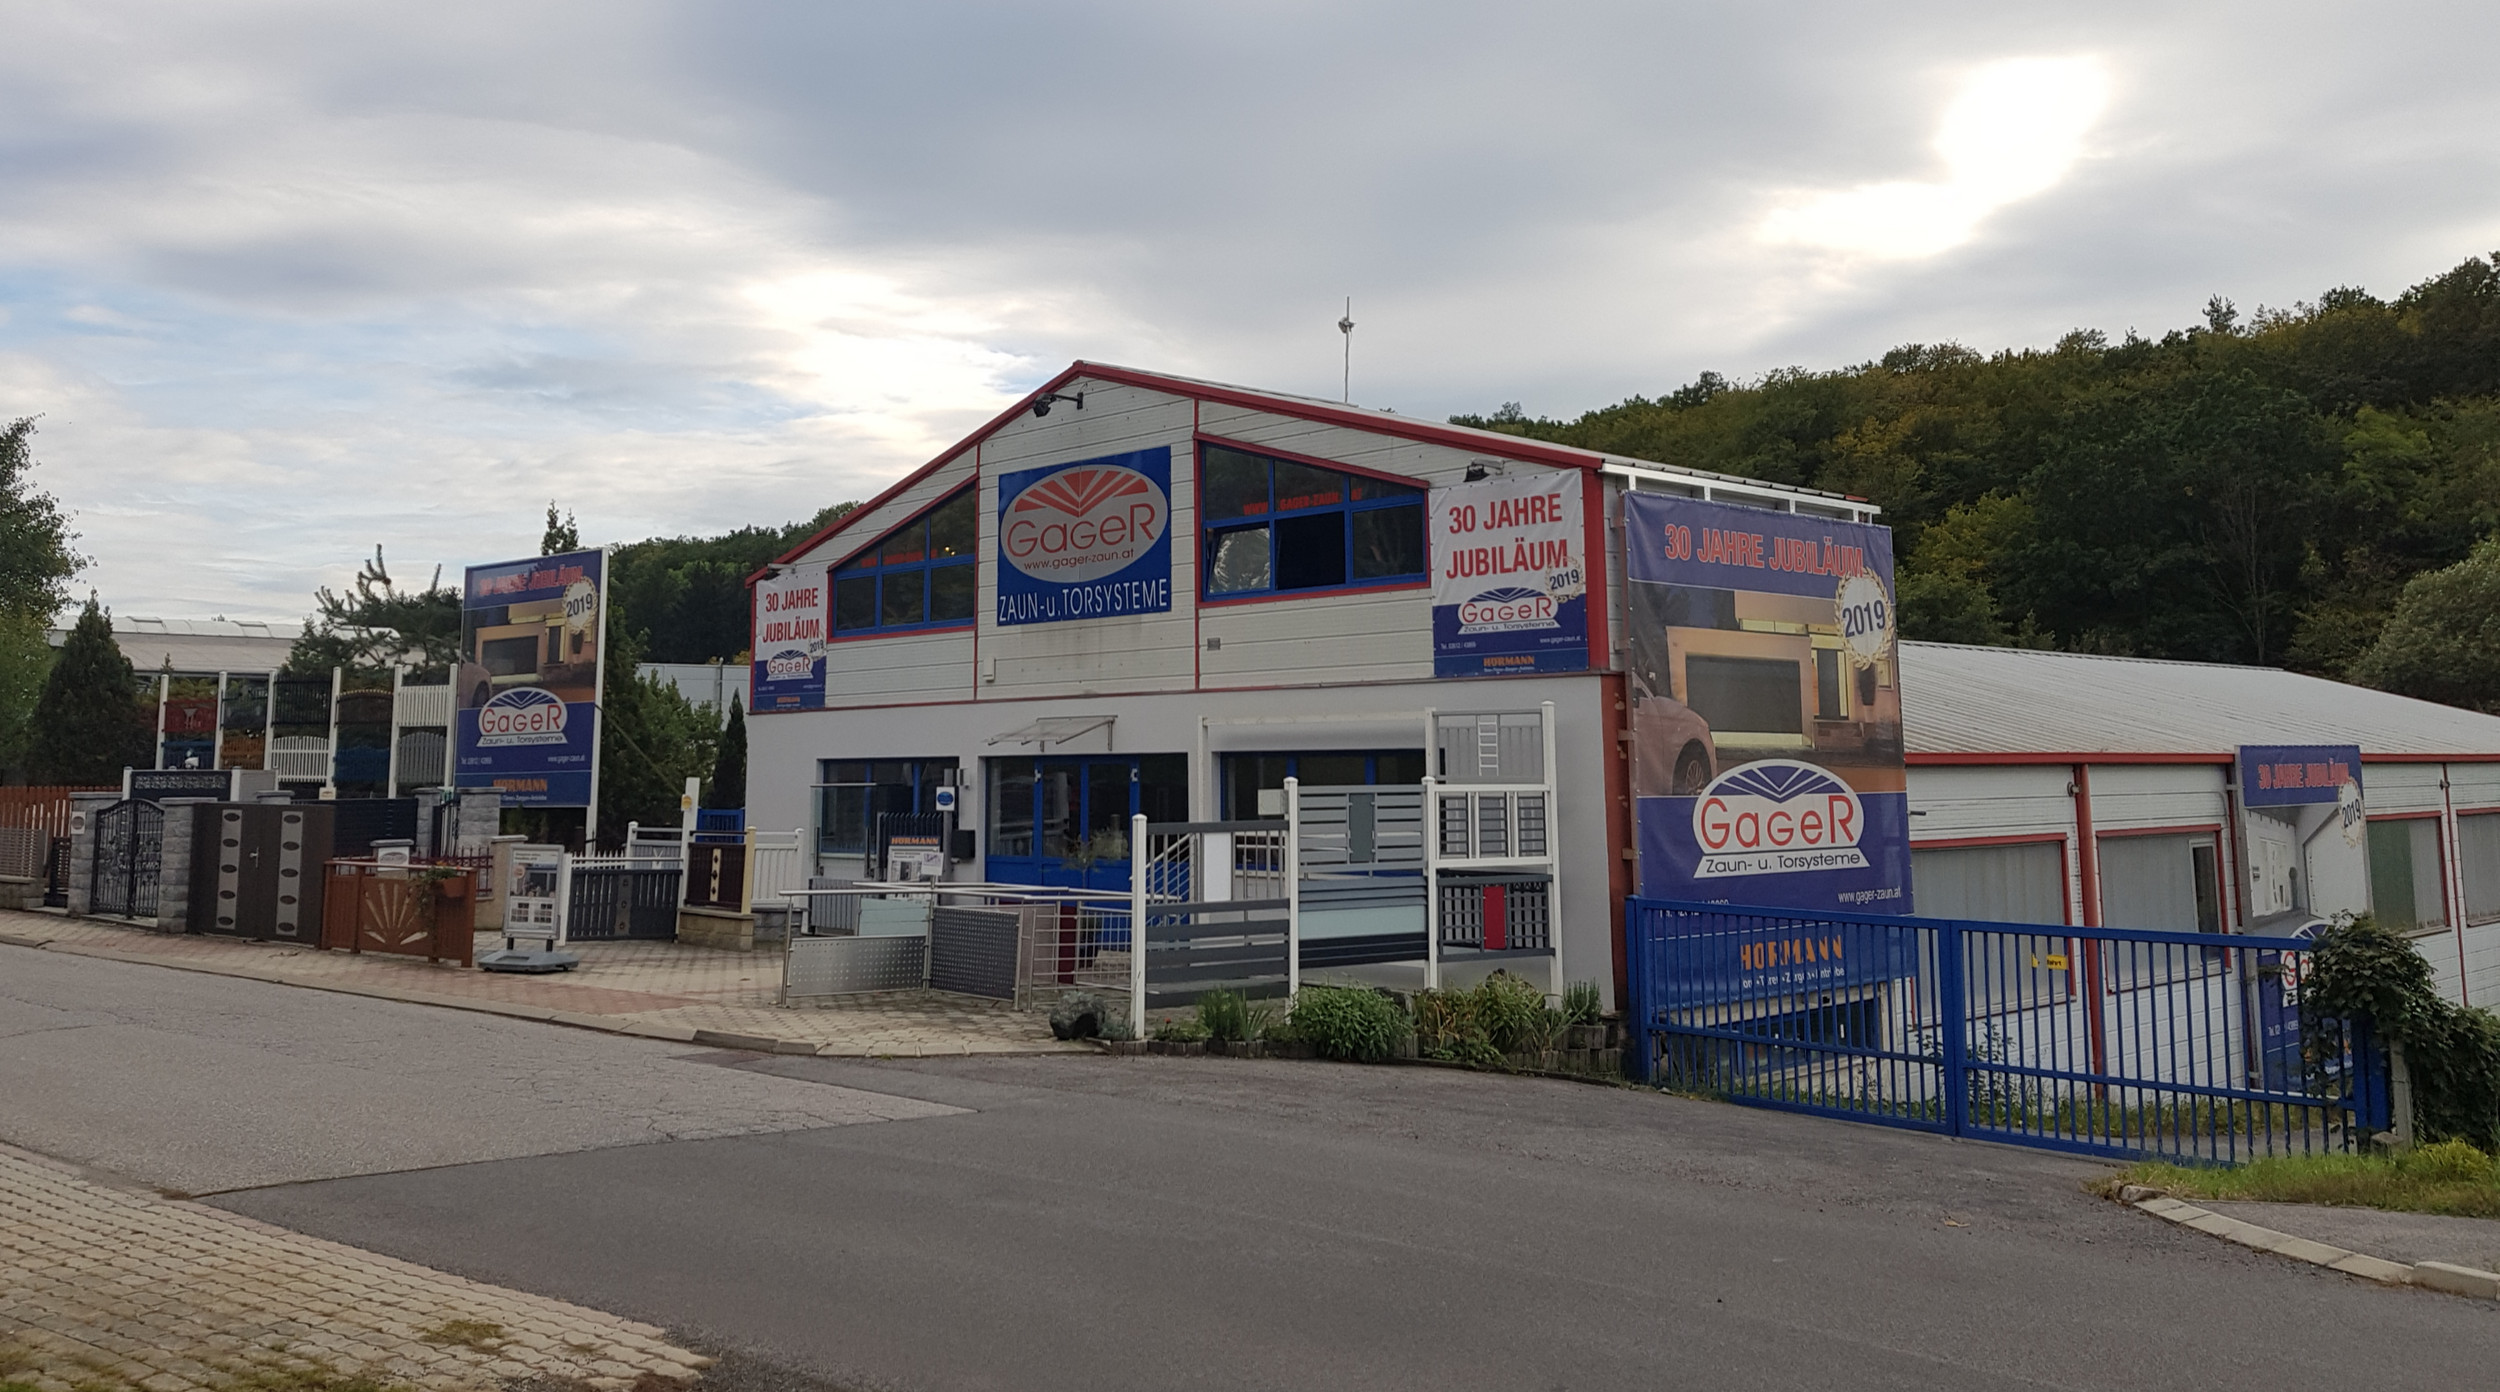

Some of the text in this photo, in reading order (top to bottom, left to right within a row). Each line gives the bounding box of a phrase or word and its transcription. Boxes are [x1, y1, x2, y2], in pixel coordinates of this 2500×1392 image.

[1449, 493, 1562, 534] 30 JAHRE
[1024, 548, 1134, 570] www.gager-zaun.at
[1446, 537, 1568, 579] JUBILÄUM
[1665, 523, 1864, 578] 30 JAHRE JUBILÄUM
[1550, 569, 1580, 590] 2019
[566, 594, 593, 617] 2019
[766, 587, 818, 612] 30 JAHRE
[763, 616, 819, 643] JUBILÄUM
[1464, 624, 1489, 632] Zaun-
[1503, 621, 1556, 631] Torsysteme
[1842, 599, 1886, 638] 2019
[810, 640, 824, 653] 2019
[2258, 764, 2272, 789] 30
[2342, 798, 2360, 829] 2019
[1706, 852, 1861, 873] Zaun- u. Torsysteme
[1838, 885, 1901, 905] www.gager-zaun.at
